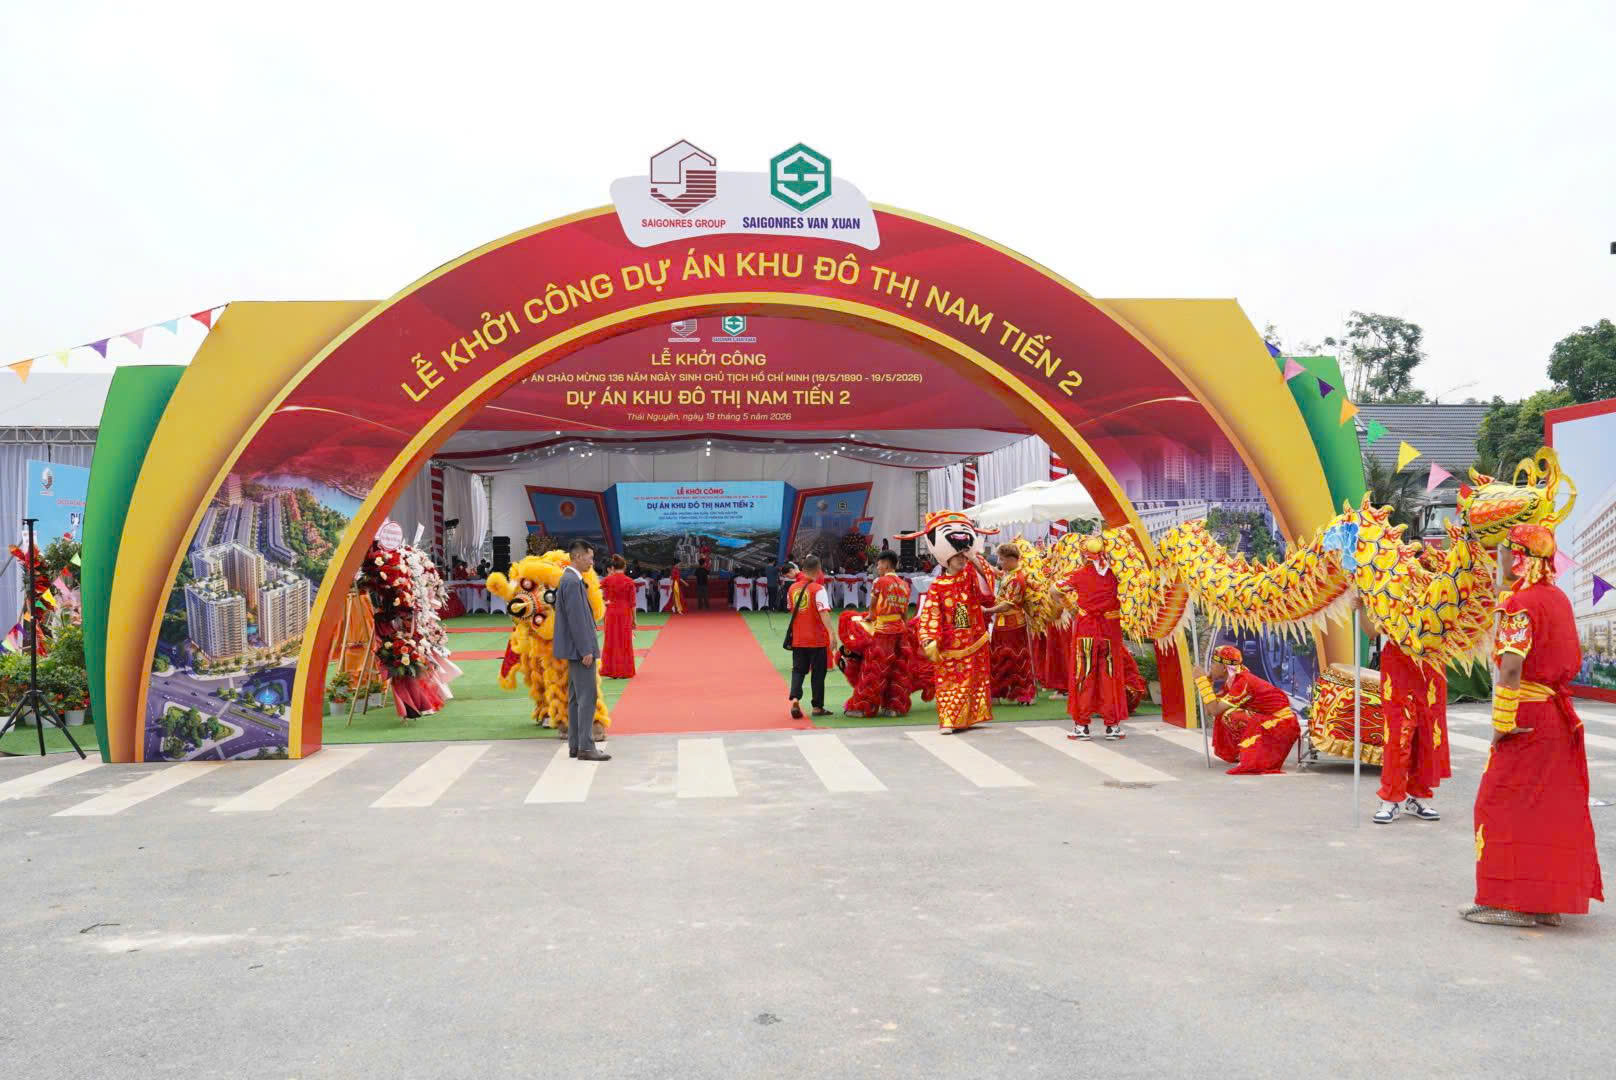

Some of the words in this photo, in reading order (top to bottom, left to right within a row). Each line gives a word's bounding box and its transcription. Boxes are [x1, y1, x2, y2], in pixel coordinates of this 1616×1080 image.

[641, 218, 693, 229] SAIGONRES
[695, 218, 727, 229] GROUP
[742, 216, 804, 230] SAIGONRES
[807, 217, 829, 230] VAN
[831, 217, 861, 230] XUAN
[400, 352, 446, 402] LỄ
[440, 311, 521, 372] KHỞI
[523, 273, 614, 324] CÔNG
[620, 258, 671, 292] DỰ
[681, 247, 726, 281] ÁN
[736, 252, 803, 278] KHU
[813, 252, 860, 285] ĐÔ
[870, 265, 920, 308] THỊ
[924, 285, 994, 334] NAM
[999, 320, 1062, 378] TIẾN
[1058, 370, 1083, 396] 2
[651, 347, 672, 366] LỄ
[675, 348, 716, 366] KHỞI
[720, 350, 767, 366] CÔNG
[546, 372, 574, 383] CHÀO
[576, 371, 606, 383] MỪNG
[608, 373, 625, 382] 136
[626, 371, 648, 382] NĂM
[650, 371, 677, 382] NGÀY
[678, 373, 702, 382] SINH
[767, 371, 784, 382] CHÍ
[785, 373, 810, 382] MINH
[811, 373, 863, 383] (19/5/1890
[871, 373, 923, 384] 19/5/2026)
[566, 390, 597, 409] DỰ
[600, 385, 627, 405] ÁN
[632, 390, 672, 405] KHU
[677, 385, 706, 405] ĐÔ
[710, 390, 741, 409] THỊ
[746, 390, 788, 405] NAM
[792, 384, 834, 405] TIẾN
[839, 390, 850, 405] 2
[706, 412, 715, 420] 19
[717, 412, 741, 422] tháng
[743, 412, 749, 420] 5
[770, 412, 792, 421] 2026
